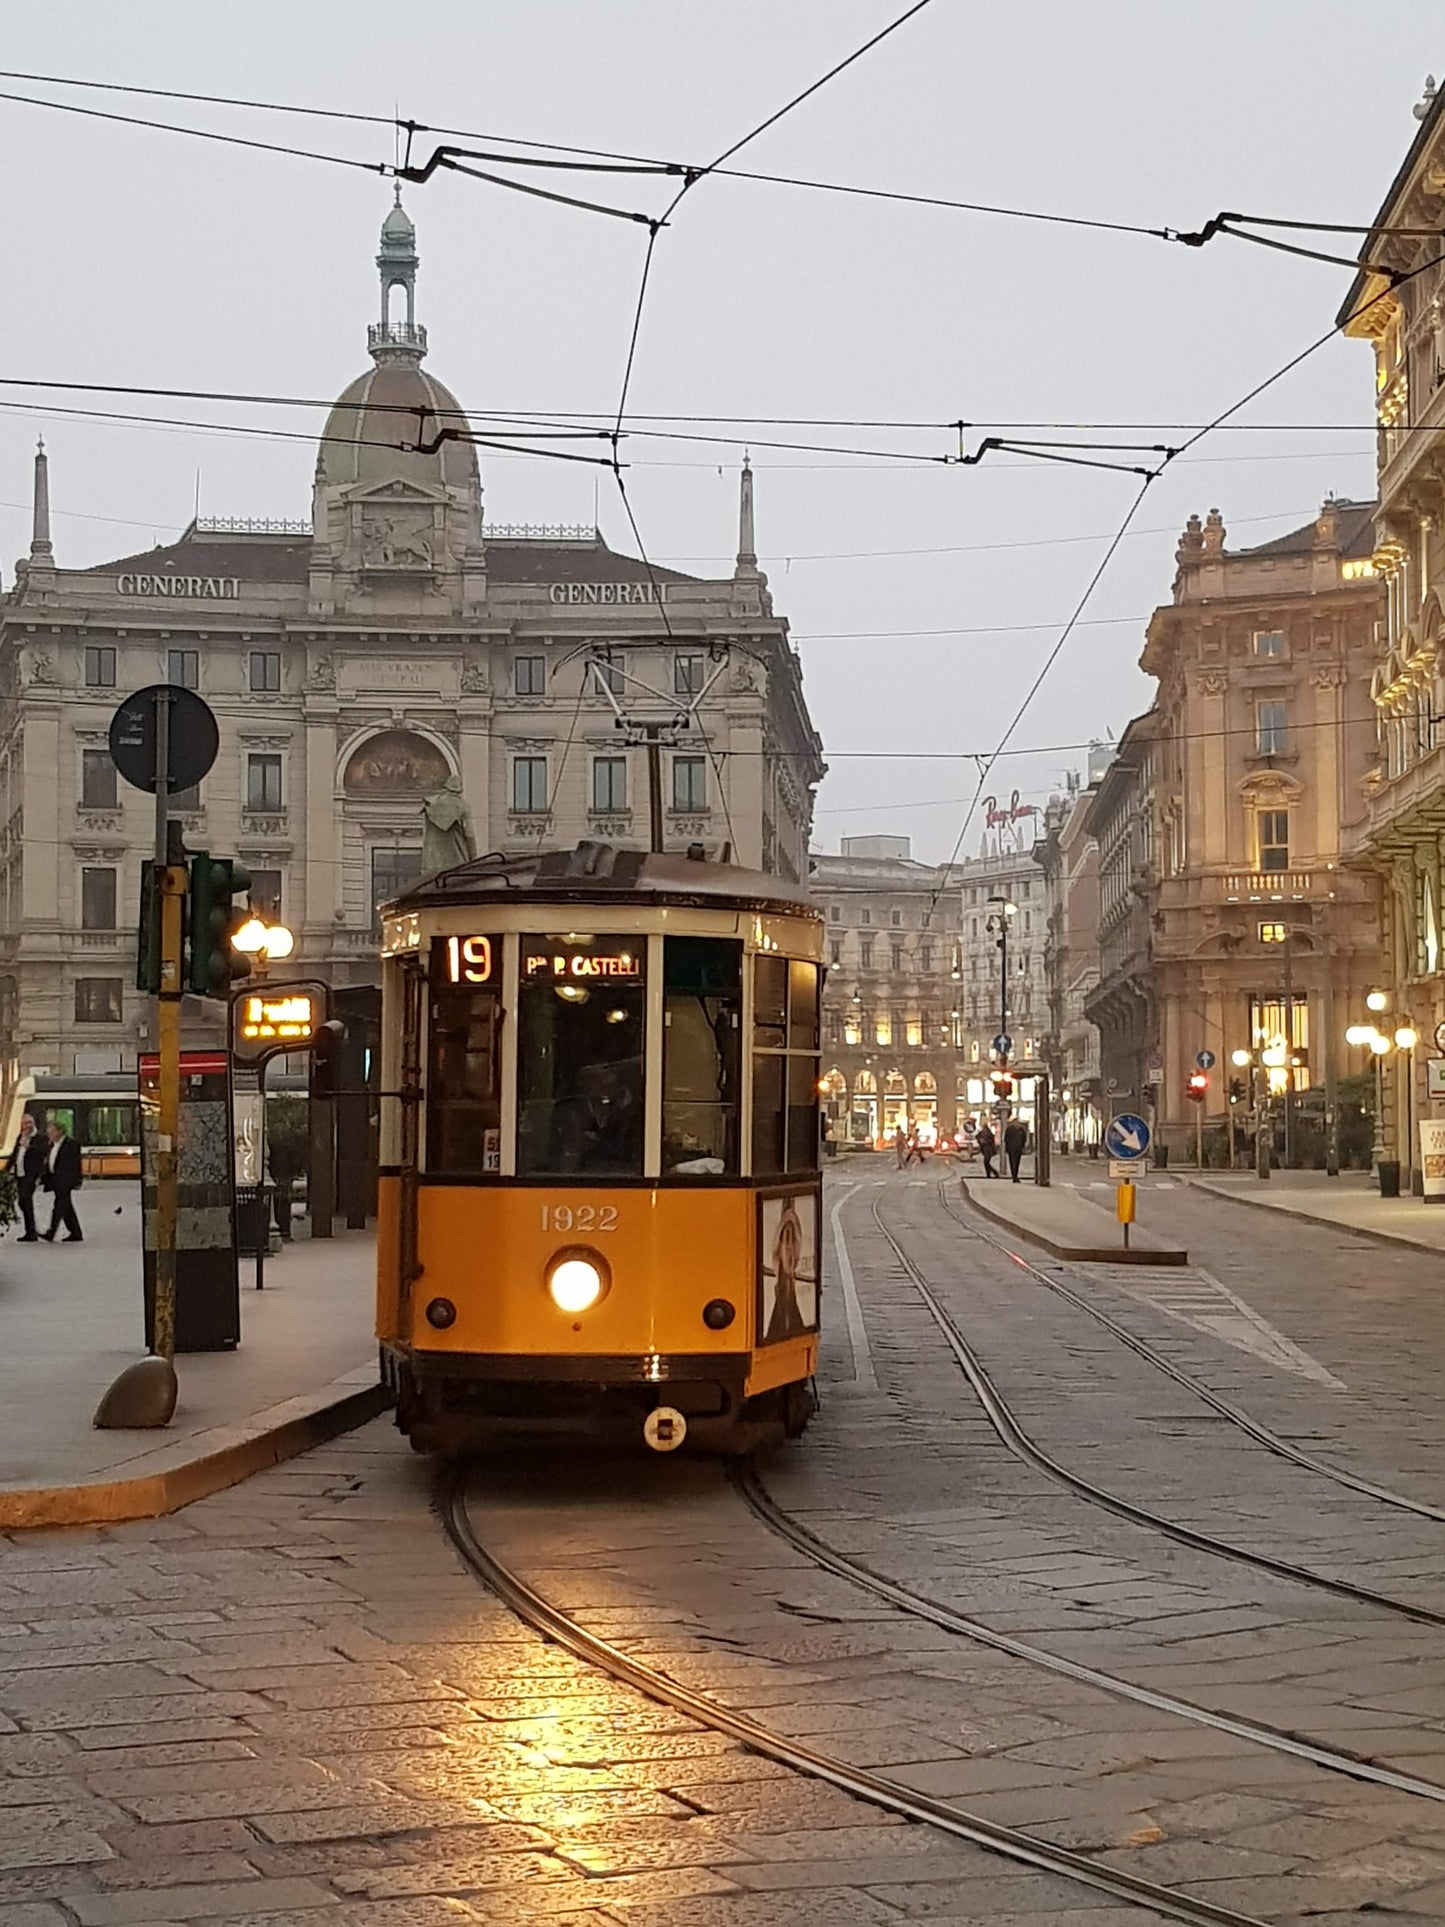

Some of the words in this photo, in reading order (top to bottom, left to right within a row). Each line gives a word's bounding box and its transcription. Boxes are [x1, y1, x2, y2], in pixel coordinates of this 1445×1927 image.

[117, 573, 240, 599] GENERALI
[549, 582, 671, 605] GENERALI
[448, 935, 492, 983] 19
[571, 956, 640, 976] CASTELLI
[541, 1205, 619, 1232] 1922
